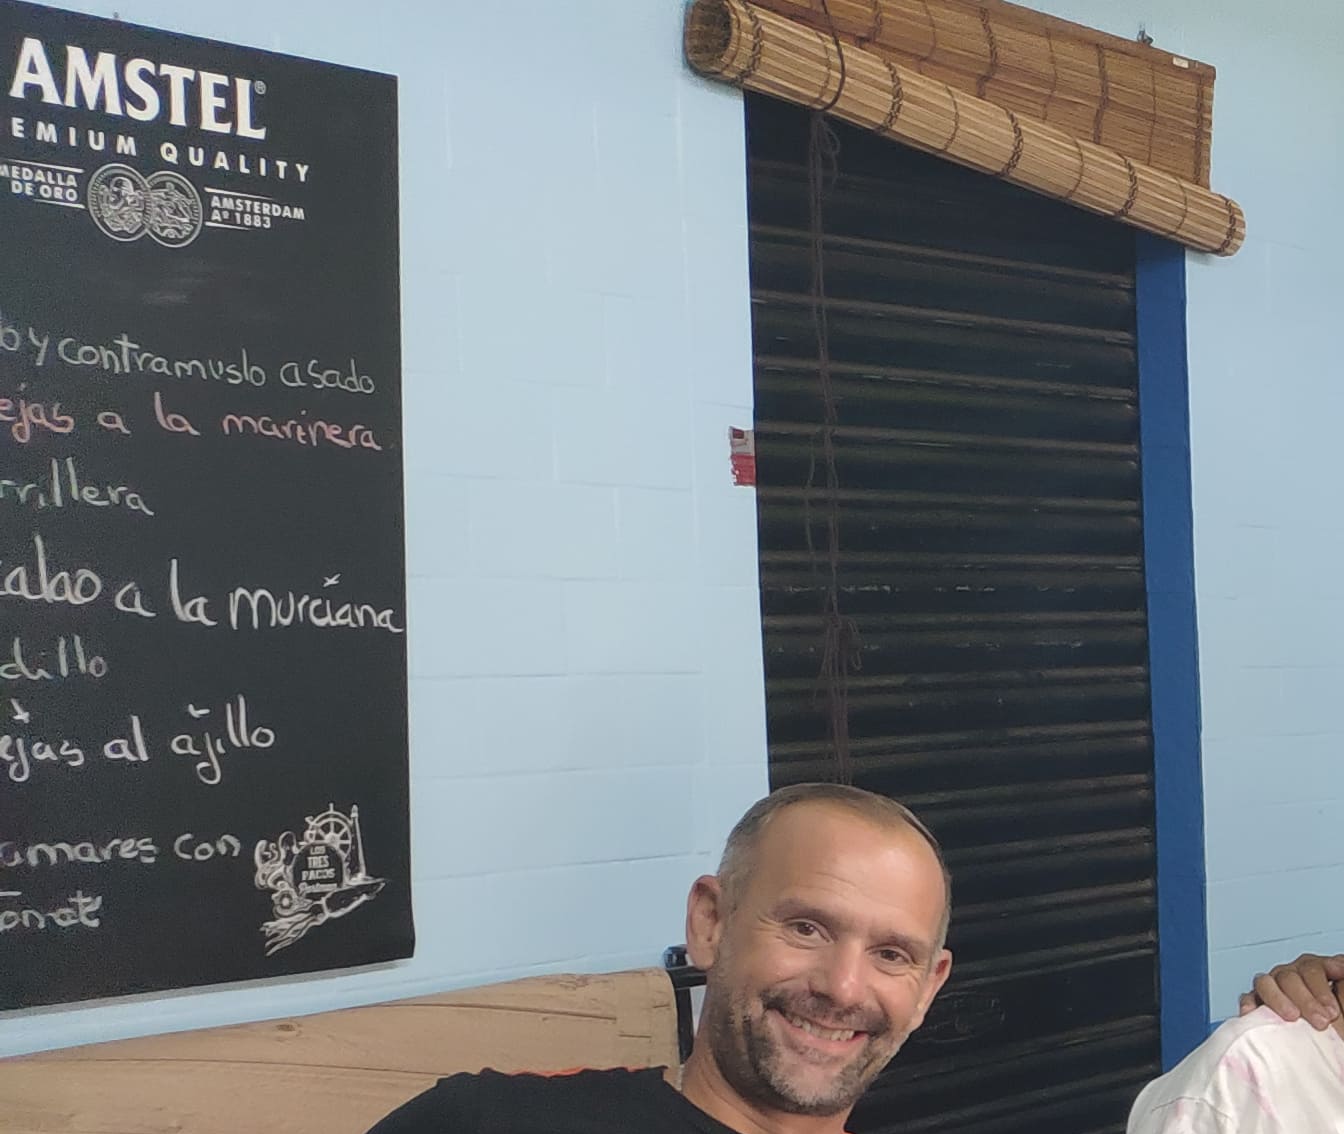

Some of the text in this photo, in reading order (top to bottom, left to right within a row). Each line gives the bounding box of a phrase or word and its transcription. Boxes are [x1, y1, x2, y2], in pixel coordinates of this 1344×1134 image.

[160, 142, 310, 183] QUALITY
[11, 180, 78, 202] DE ORO
[210, 195, 305, 220] AMSTERDAM
[234, 212, 271, 229] 1883
[58, 333, 266, 387] contramuslo
[280, 358, 376, 394] asado
[97, 411, 131, 434] a
[154, 391, 200, 436] la
[222, 410, 383, 451] marinera
[114, 582, 156, 617] a
[171, 558, 218, 627] la
[104, 715, 149, 761] al
[171, 694, 275, 784] ajillo
[302, 867, 336, 881] PACOS
[307, 855, 330, 869] TRES
